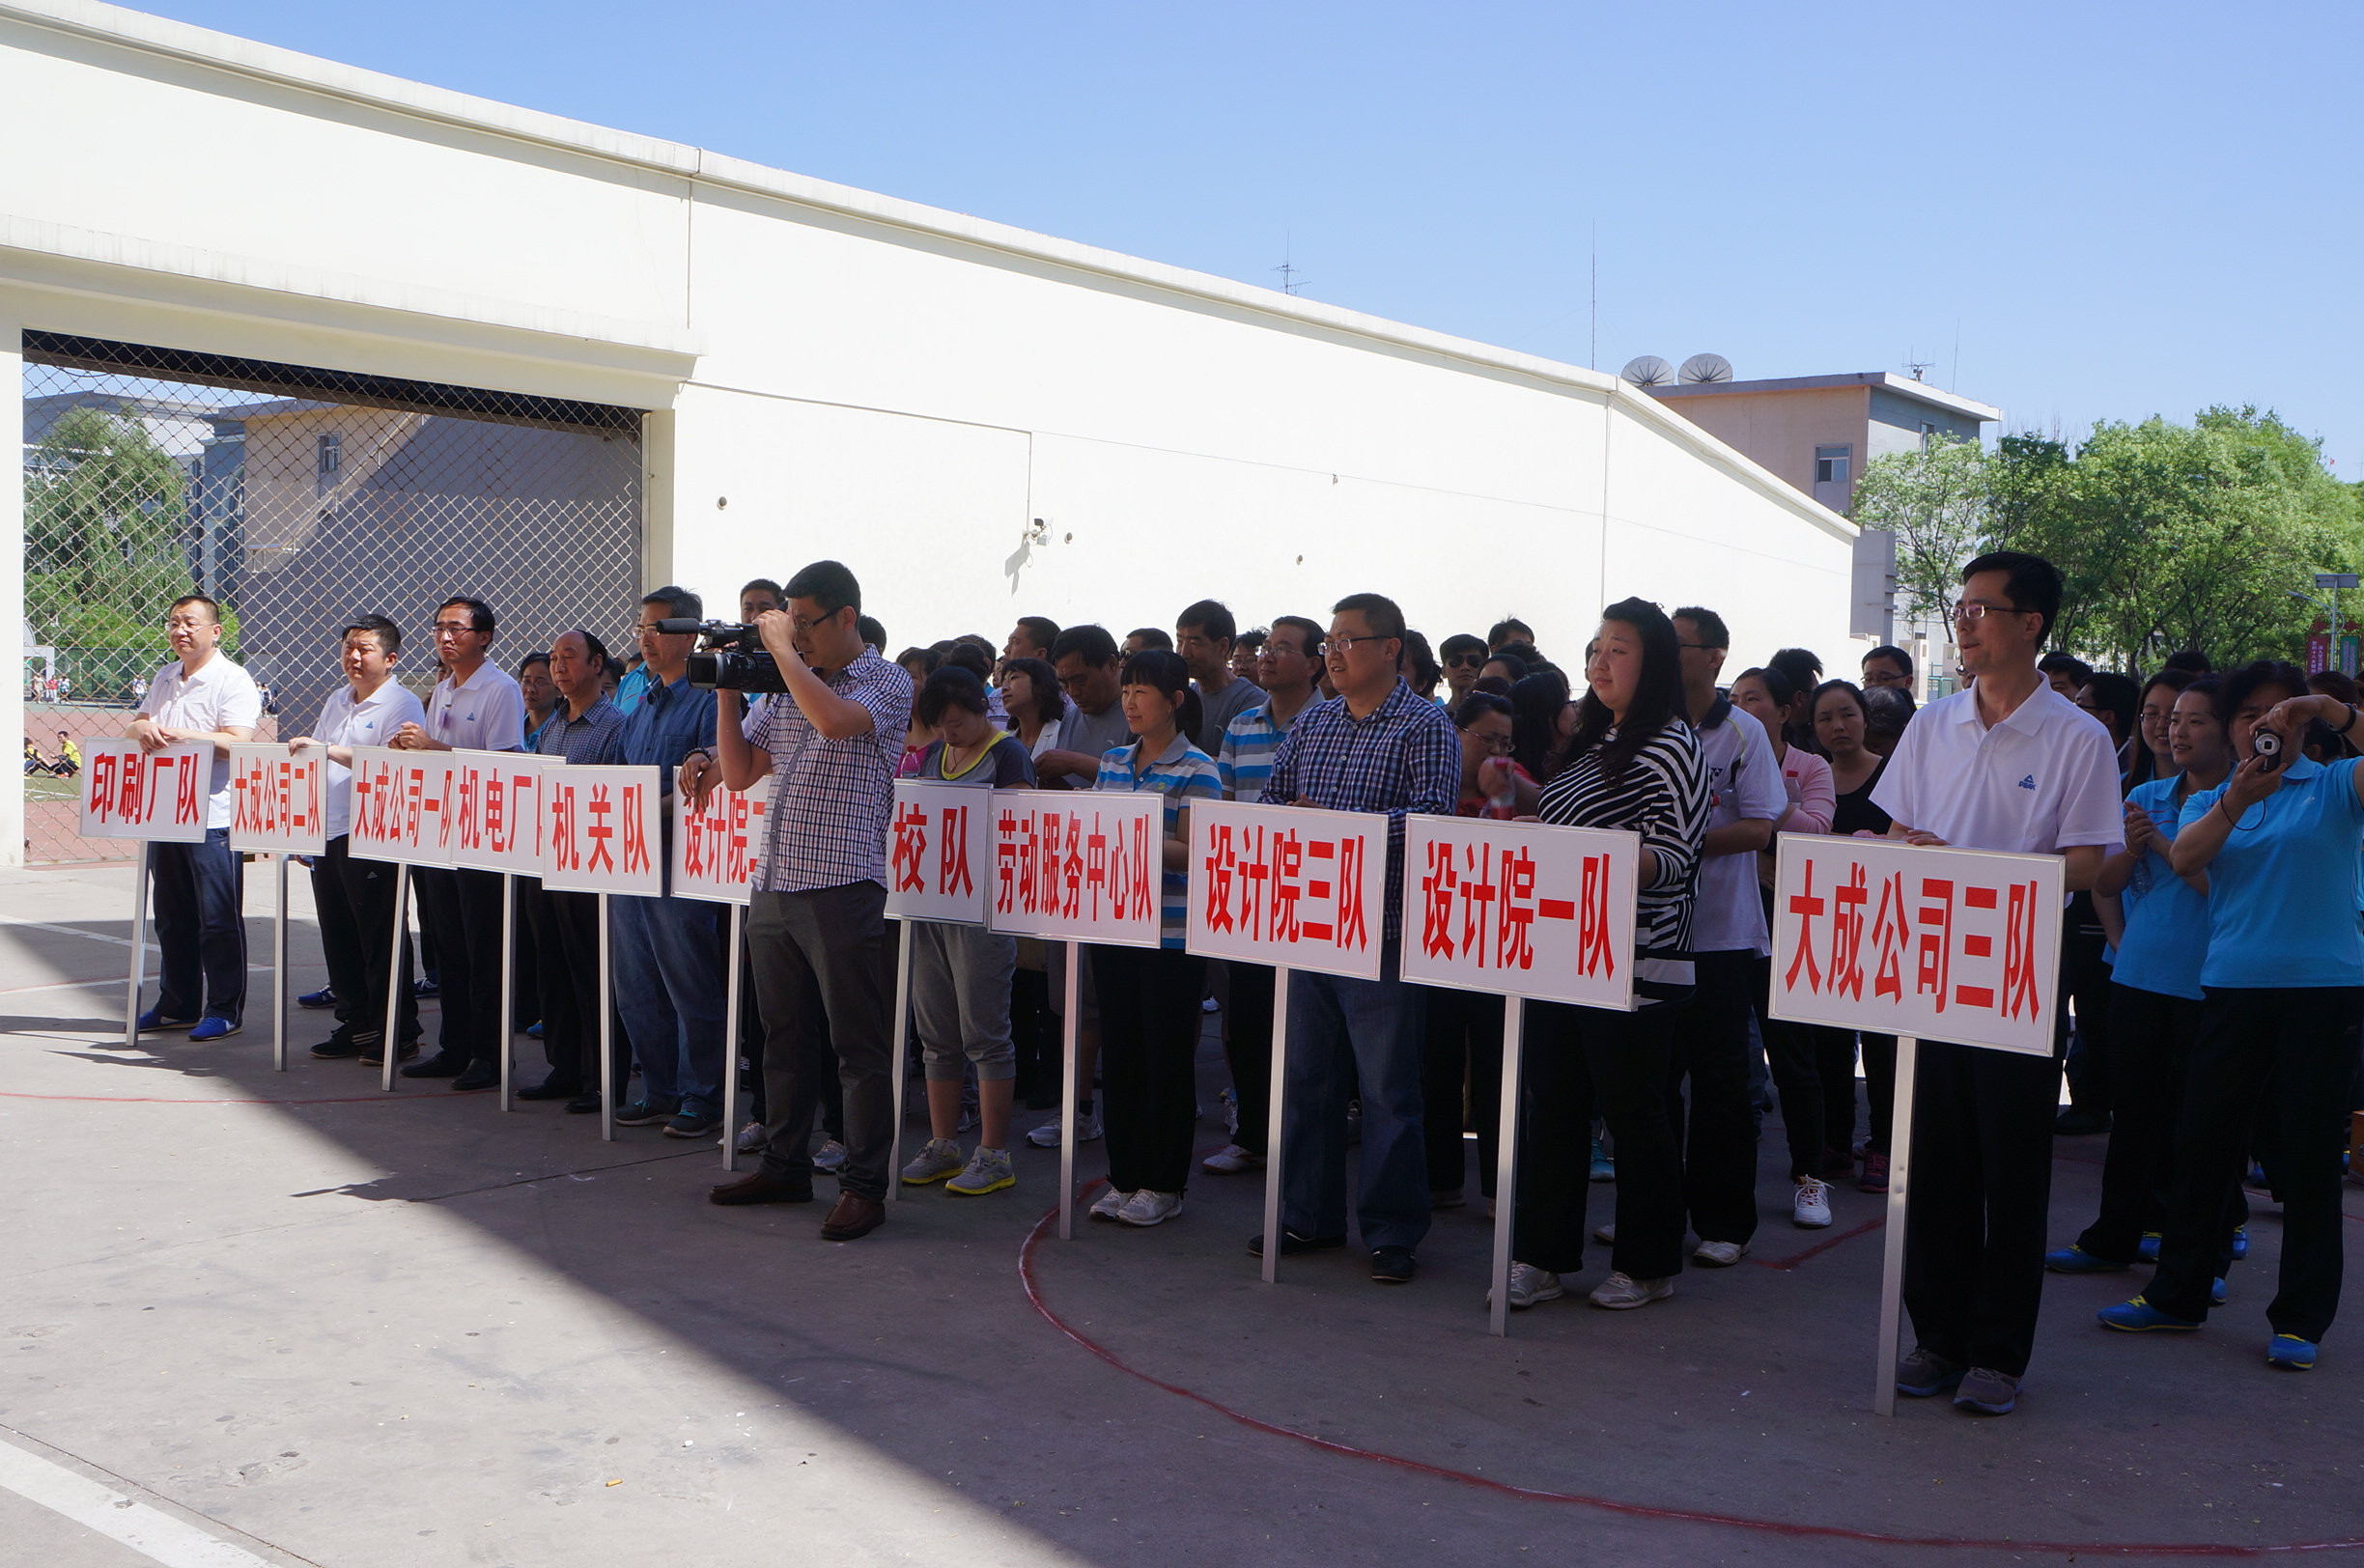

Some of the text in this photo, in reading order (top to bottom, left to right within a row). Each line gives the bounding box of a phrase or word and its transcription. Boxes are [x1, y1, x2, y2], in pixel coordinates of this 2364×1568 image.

[91, 751, 199, 826] 印刷厂队
[235, 762, 320, 838] 大成公司二队
[458, 765, 542, 856] 机电厂
[552, 783, 650, 875] 机关队
[891, 802, 974, 898] 校队
[998, 809, 1154, 924] 劳动服务中心队
[1206, 823, 1368, 954] 设计院三队
[1422, 840, 1615, 981] 设计院一队
[1786, 858, 2040, 1024] 大成公司三队
